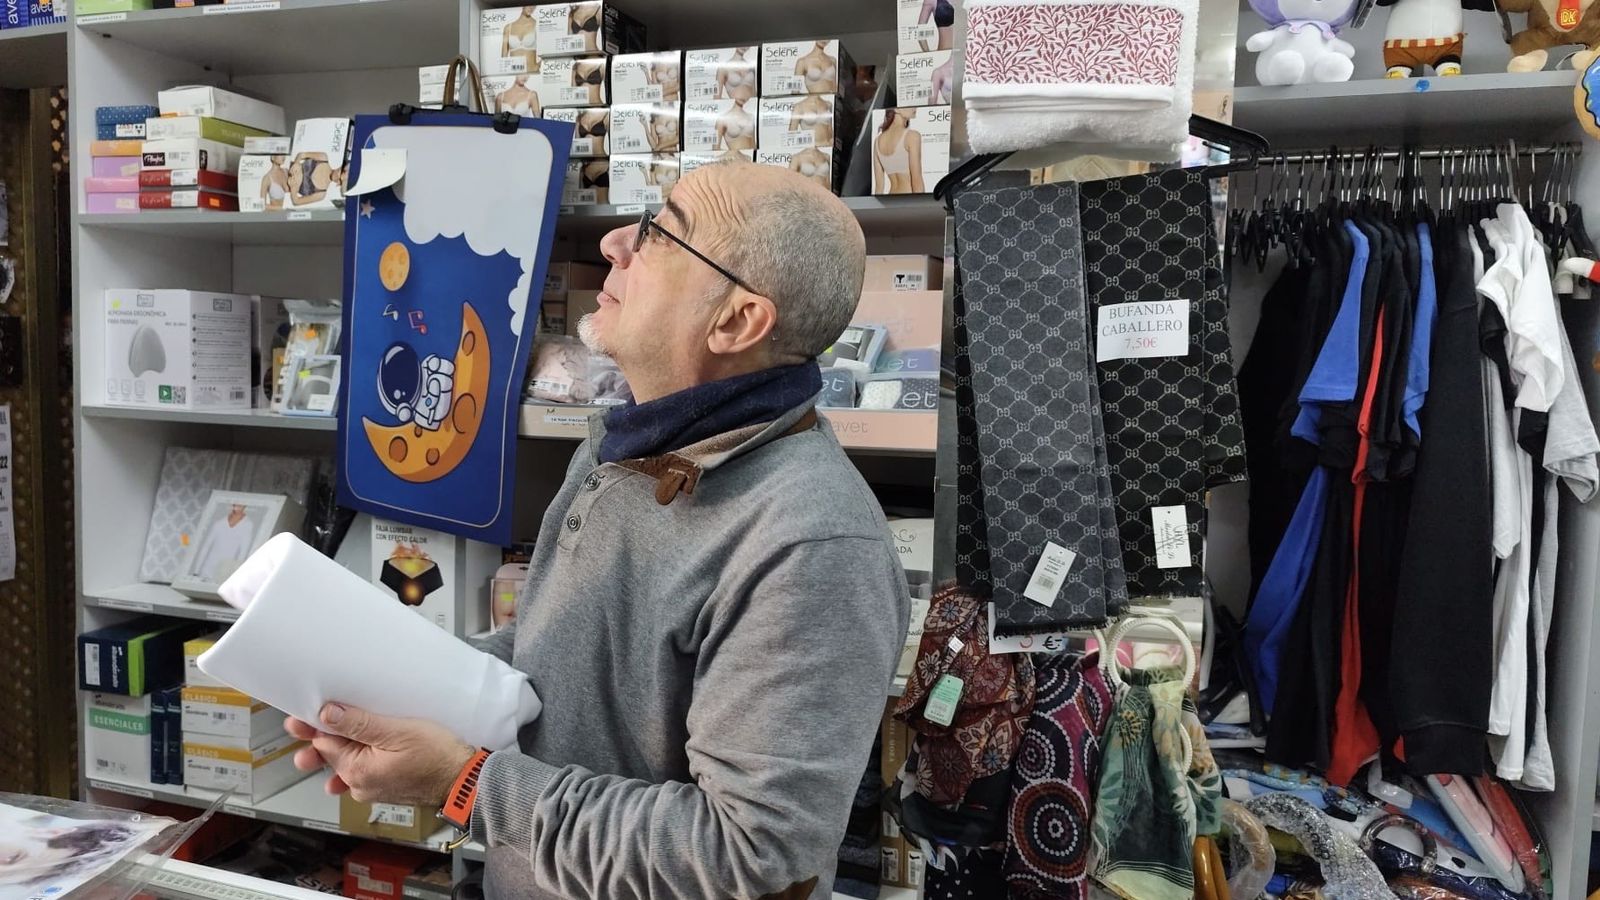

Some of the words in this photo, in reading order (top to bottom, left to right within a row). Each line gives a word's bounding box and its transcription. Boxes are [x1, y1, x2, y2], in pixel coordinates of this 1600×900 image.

[482, 13, 506, 23] Selene
[539, 8, 567, 19] Selene
[1561, 8, 1578, 24] DK
[766, 46, 799, 57] Selene
[543, 61, 571, 71] Selene
[900, 57, 934, 69] Selene
[763, 102, 795, 112] Selene
[760, 153, 792, 163] Selene
[1109, 303, 1174, 319] BUFANDA
[1102, 320, 1182, 337] CABALLERO
[1124, 337, 1158, 349] 7,50€
[376, 524, 388, 532] FAJA
[388, 534, 408, 542] EFECTO
[409, 536, 428, 544] CALOR
[94, 714, 144, 731] ESENCIALES
